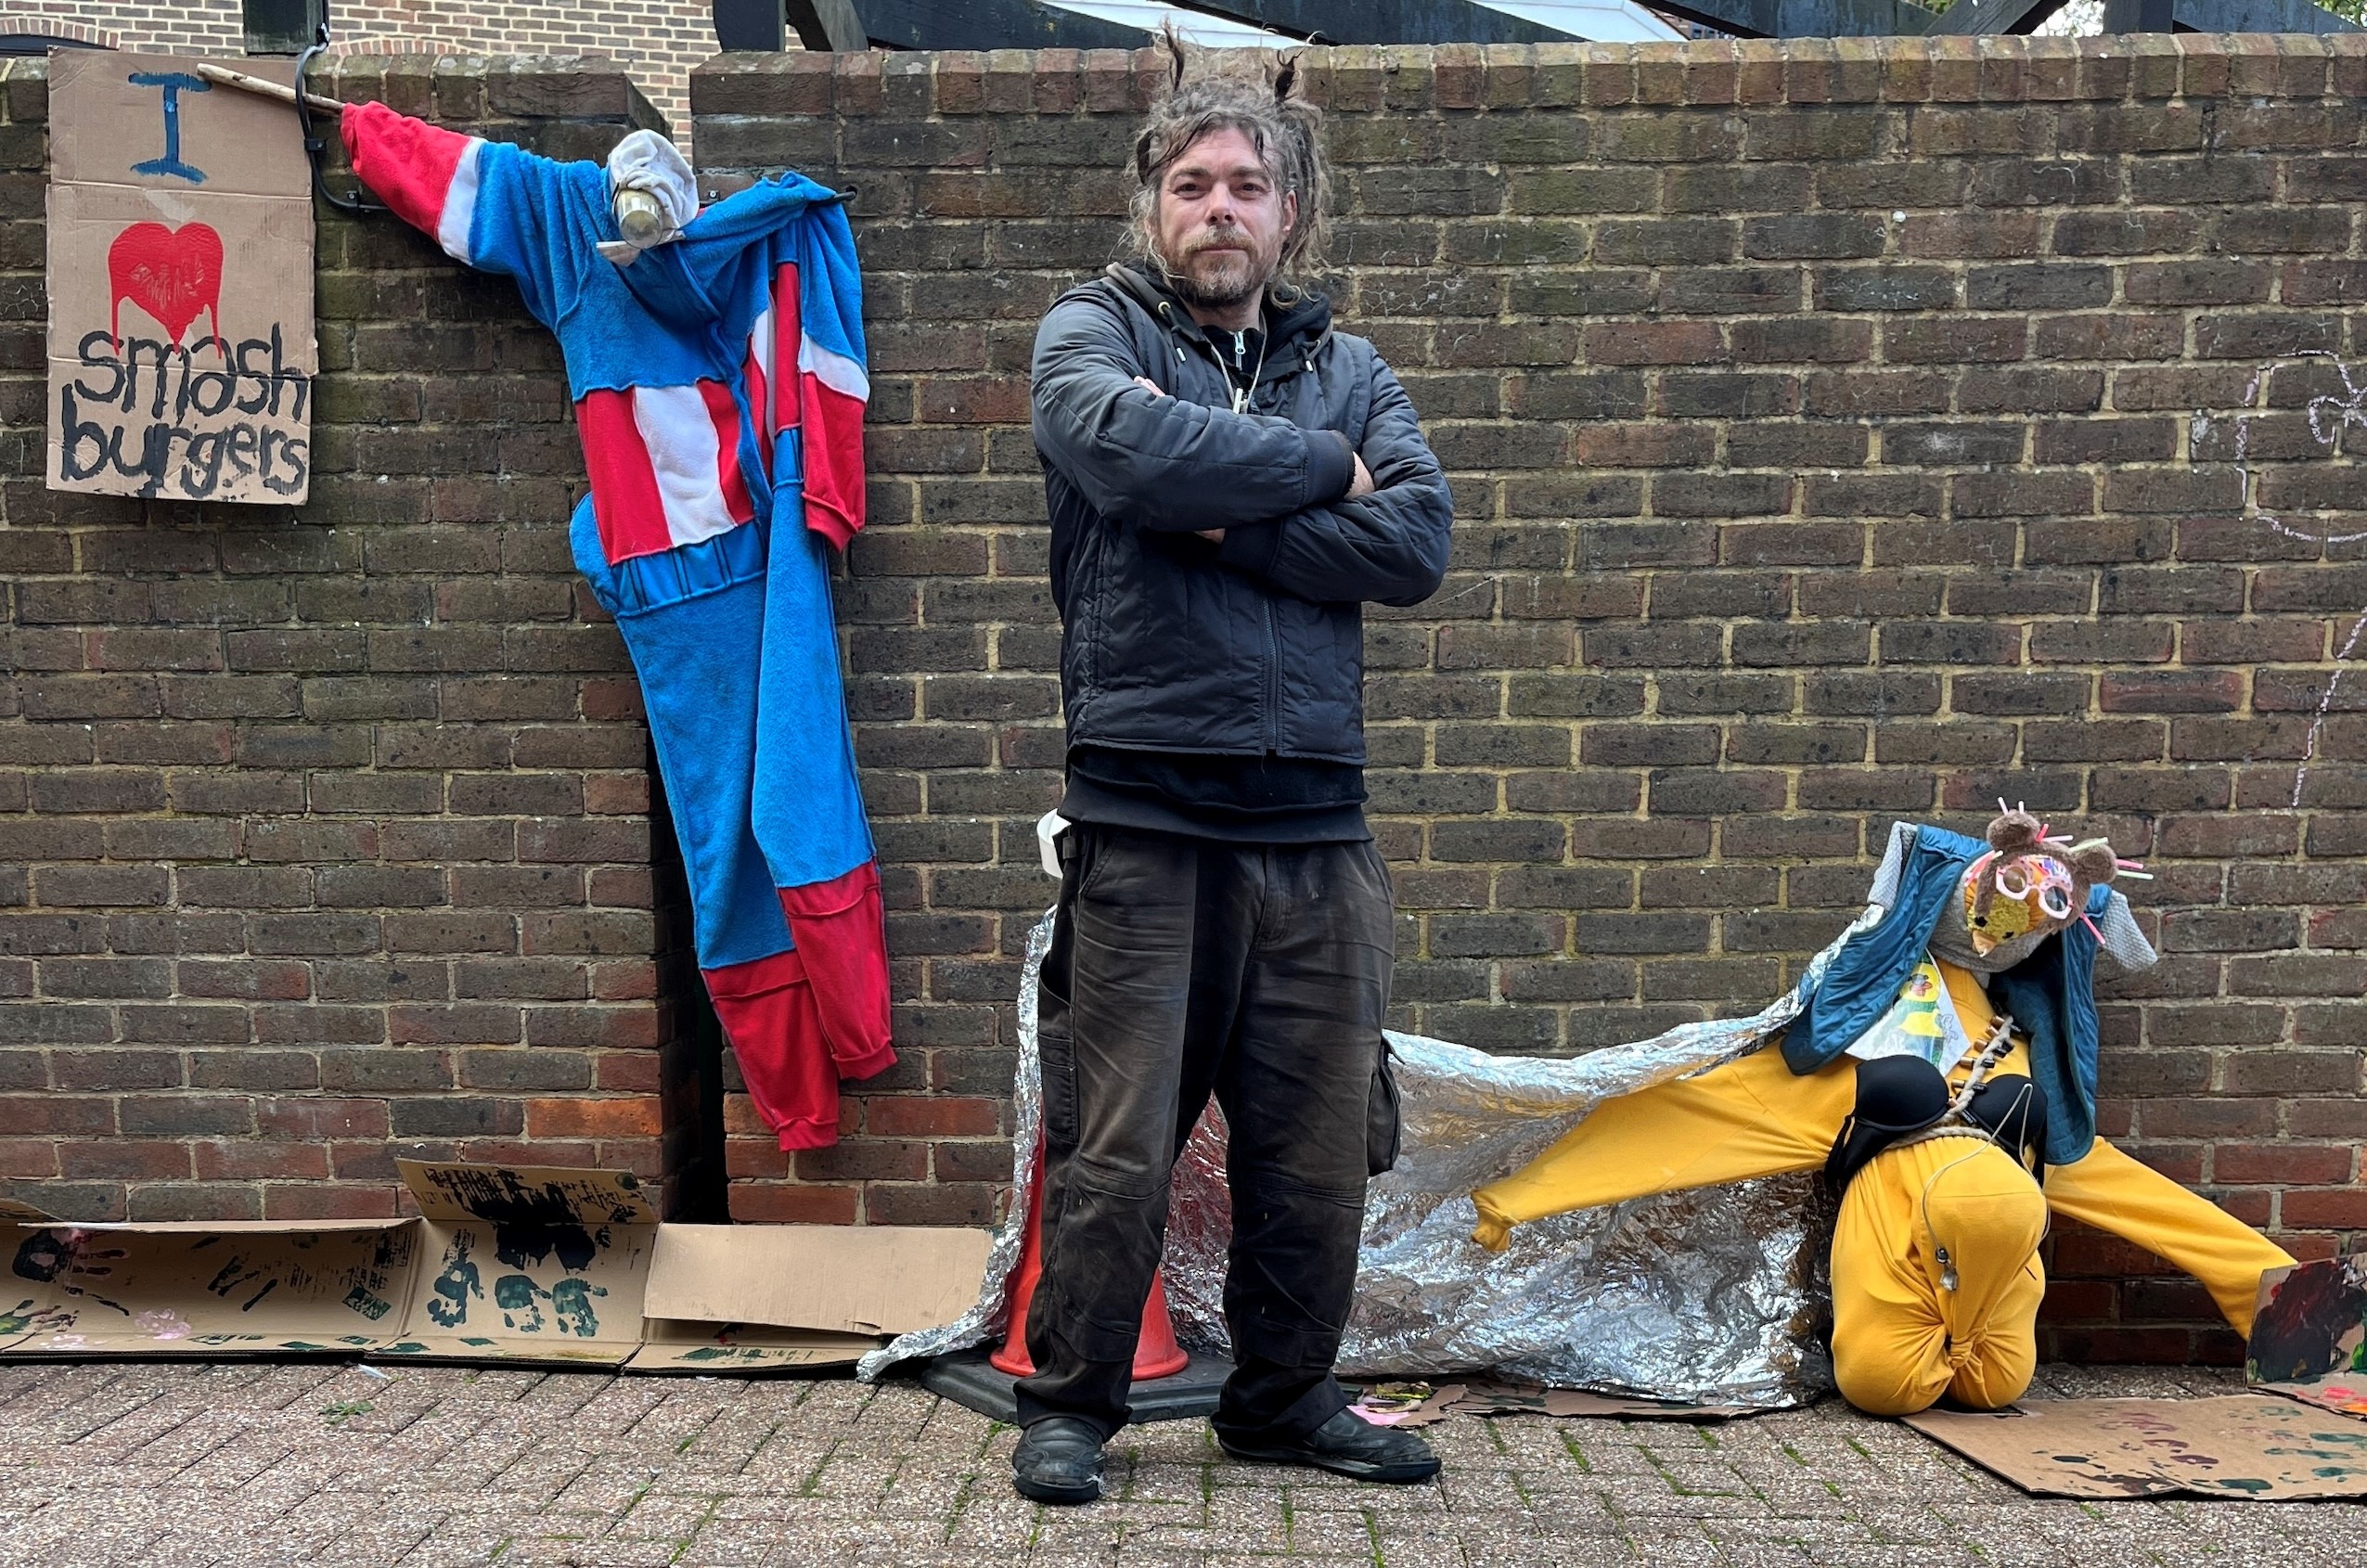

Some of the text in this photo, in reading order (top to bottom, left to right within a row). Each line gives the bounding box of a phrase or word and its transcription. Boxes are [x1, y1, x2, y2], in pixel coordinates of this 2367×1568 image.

[128, 71, 212, 186] I
[74, 321, 310, 426] smash
[61, 383, 308, 499] burgers
